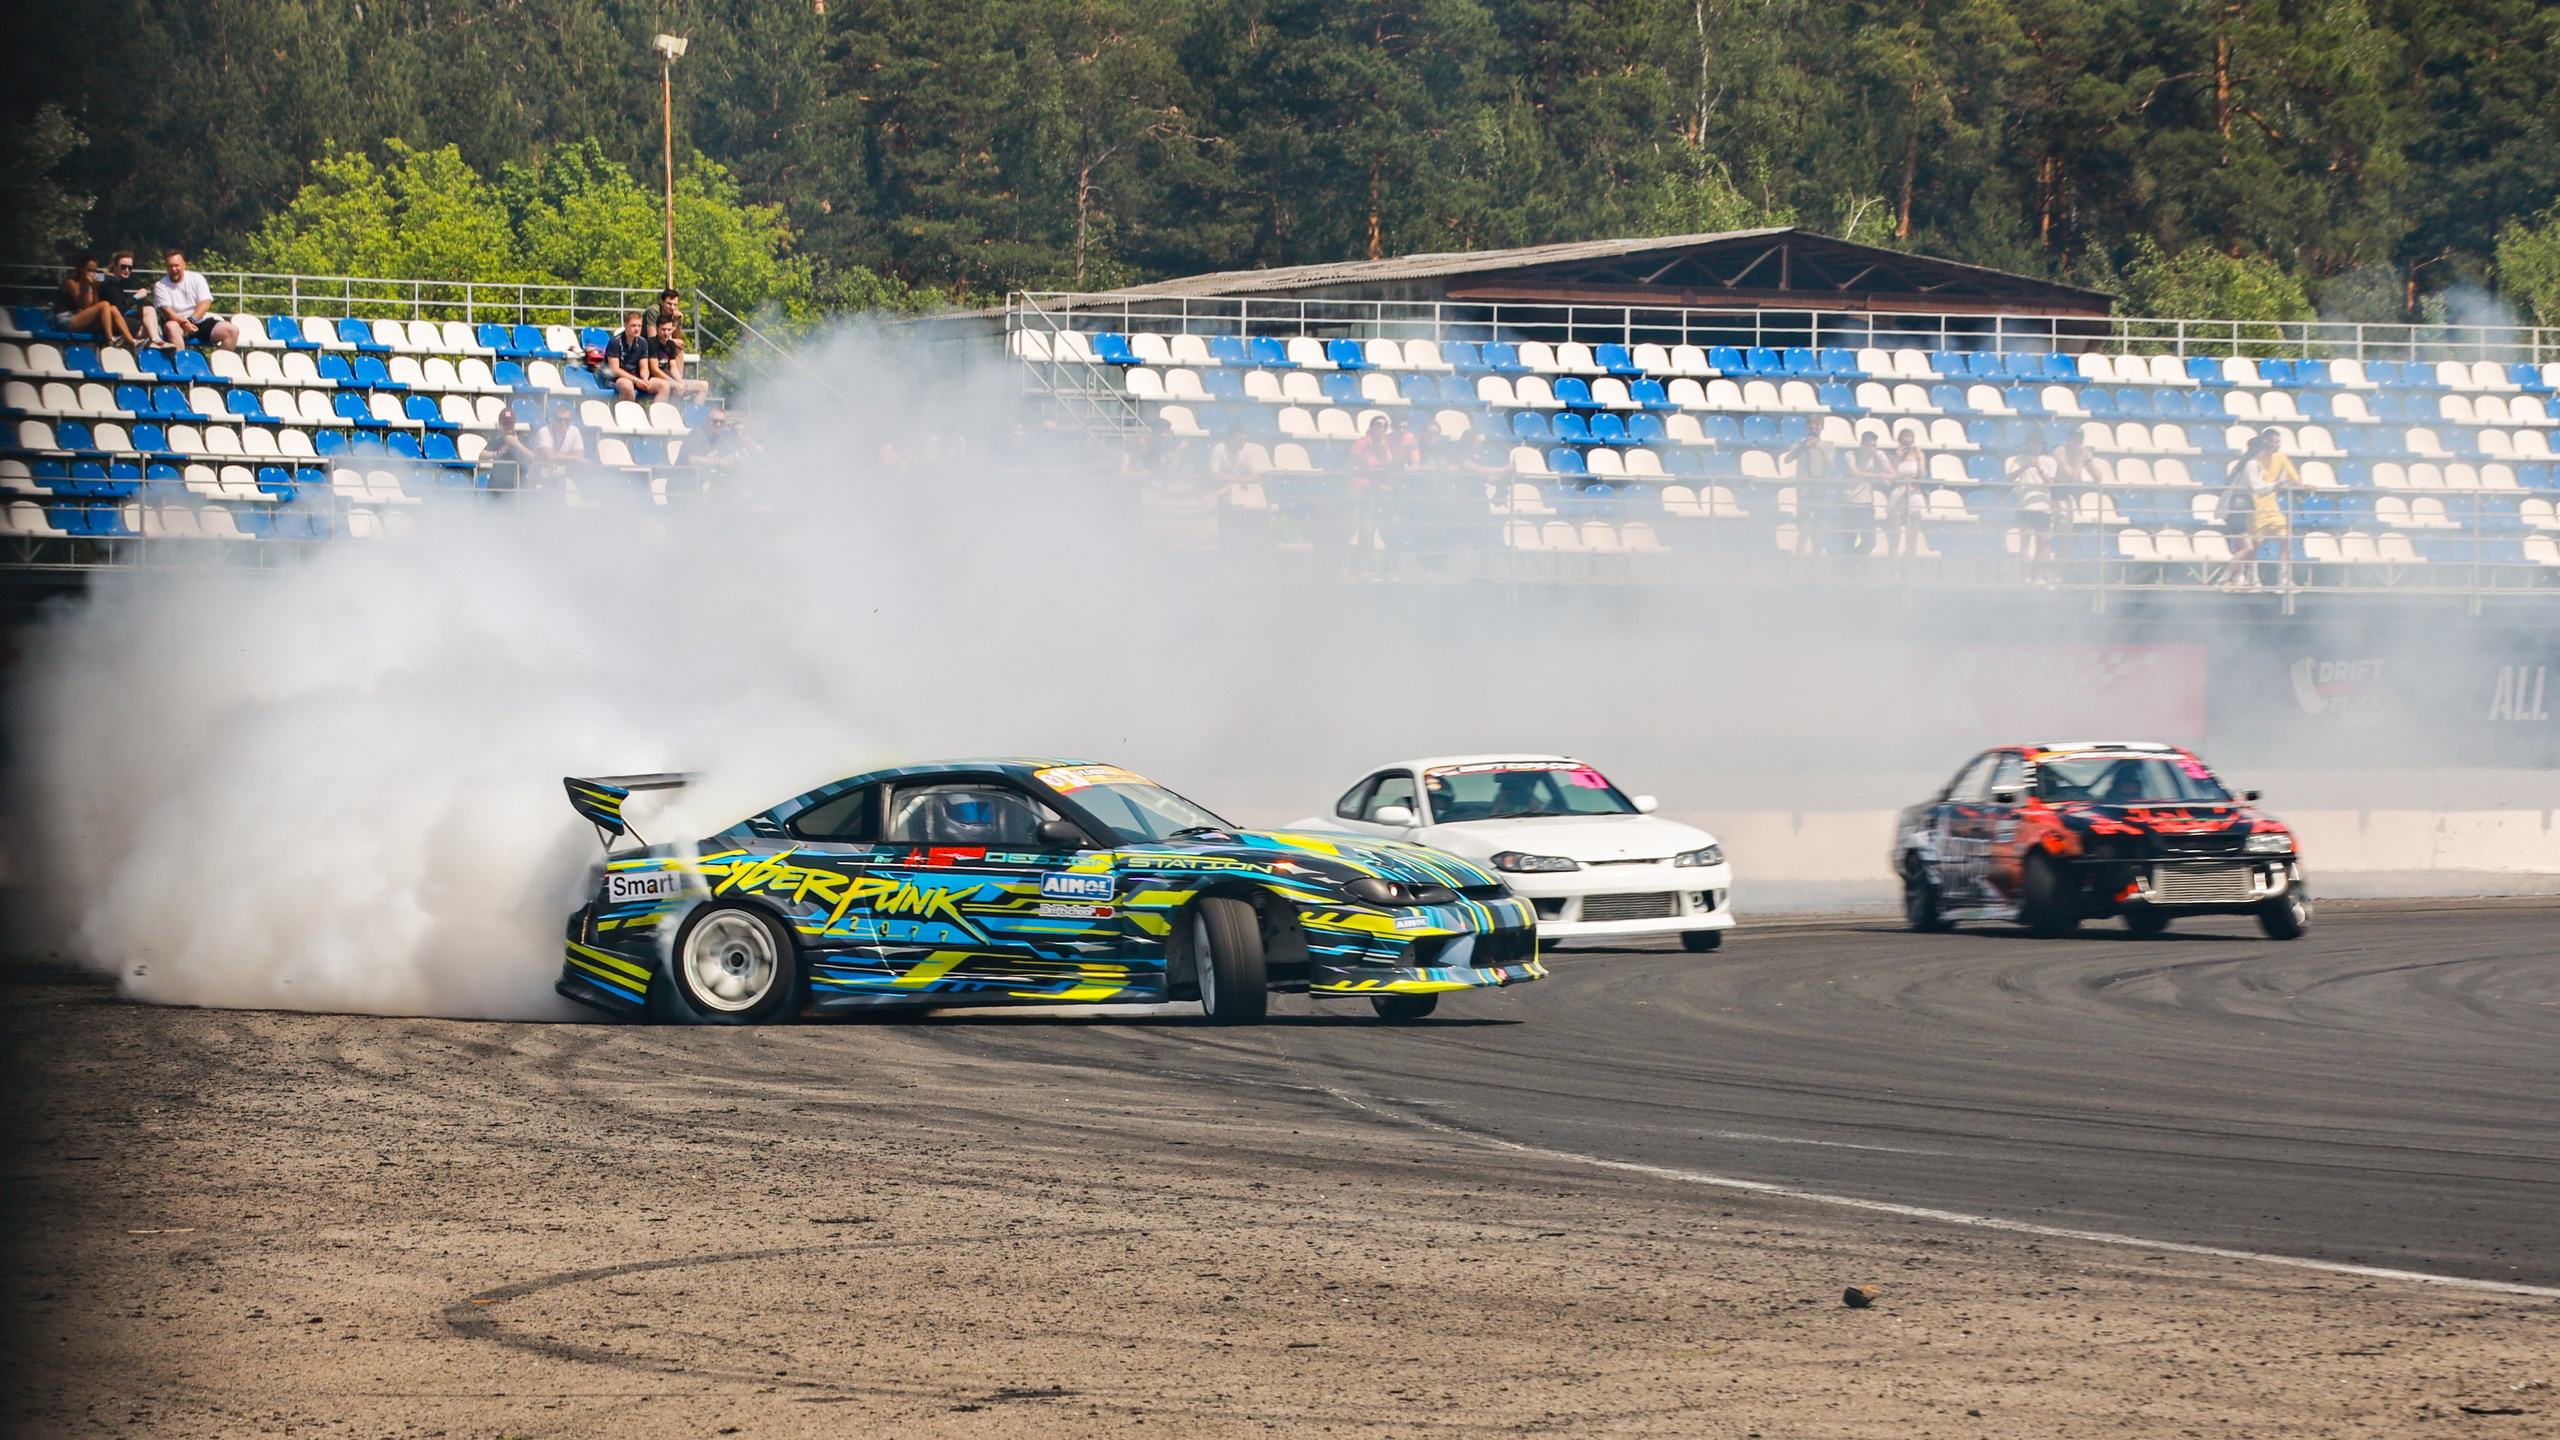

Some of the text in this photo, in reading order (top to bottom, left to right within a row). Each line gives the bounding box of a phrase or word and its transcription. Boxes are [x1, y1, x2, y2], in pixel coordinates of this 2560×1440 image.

[2319, 659, 2386, 683] DRIFT
[2488, 665, 2548, 721] ALL
[985, 852, 1273, 875] DESIGN STATION
[1043, 877, 1111, 894] AIMOL
